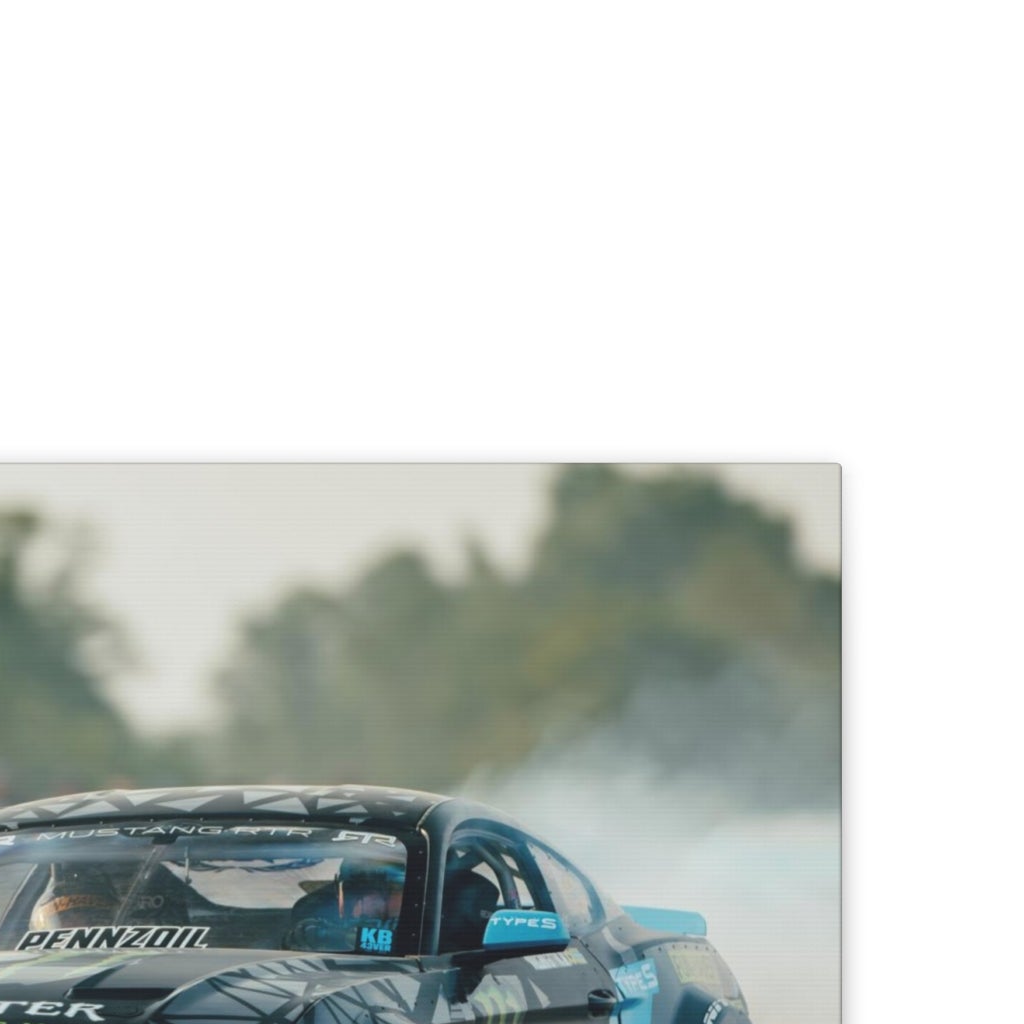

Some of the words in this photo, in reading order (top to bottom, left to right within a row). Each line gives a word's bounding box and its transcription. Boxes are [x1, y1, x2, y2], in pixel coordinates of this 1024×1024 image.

[36, 825, 224, 841] MUSTANG
[234, 826, 313, 838] RTR
[14, 925, 211, 951] PENNZOIL
[360, 927, 393, 945] KB
